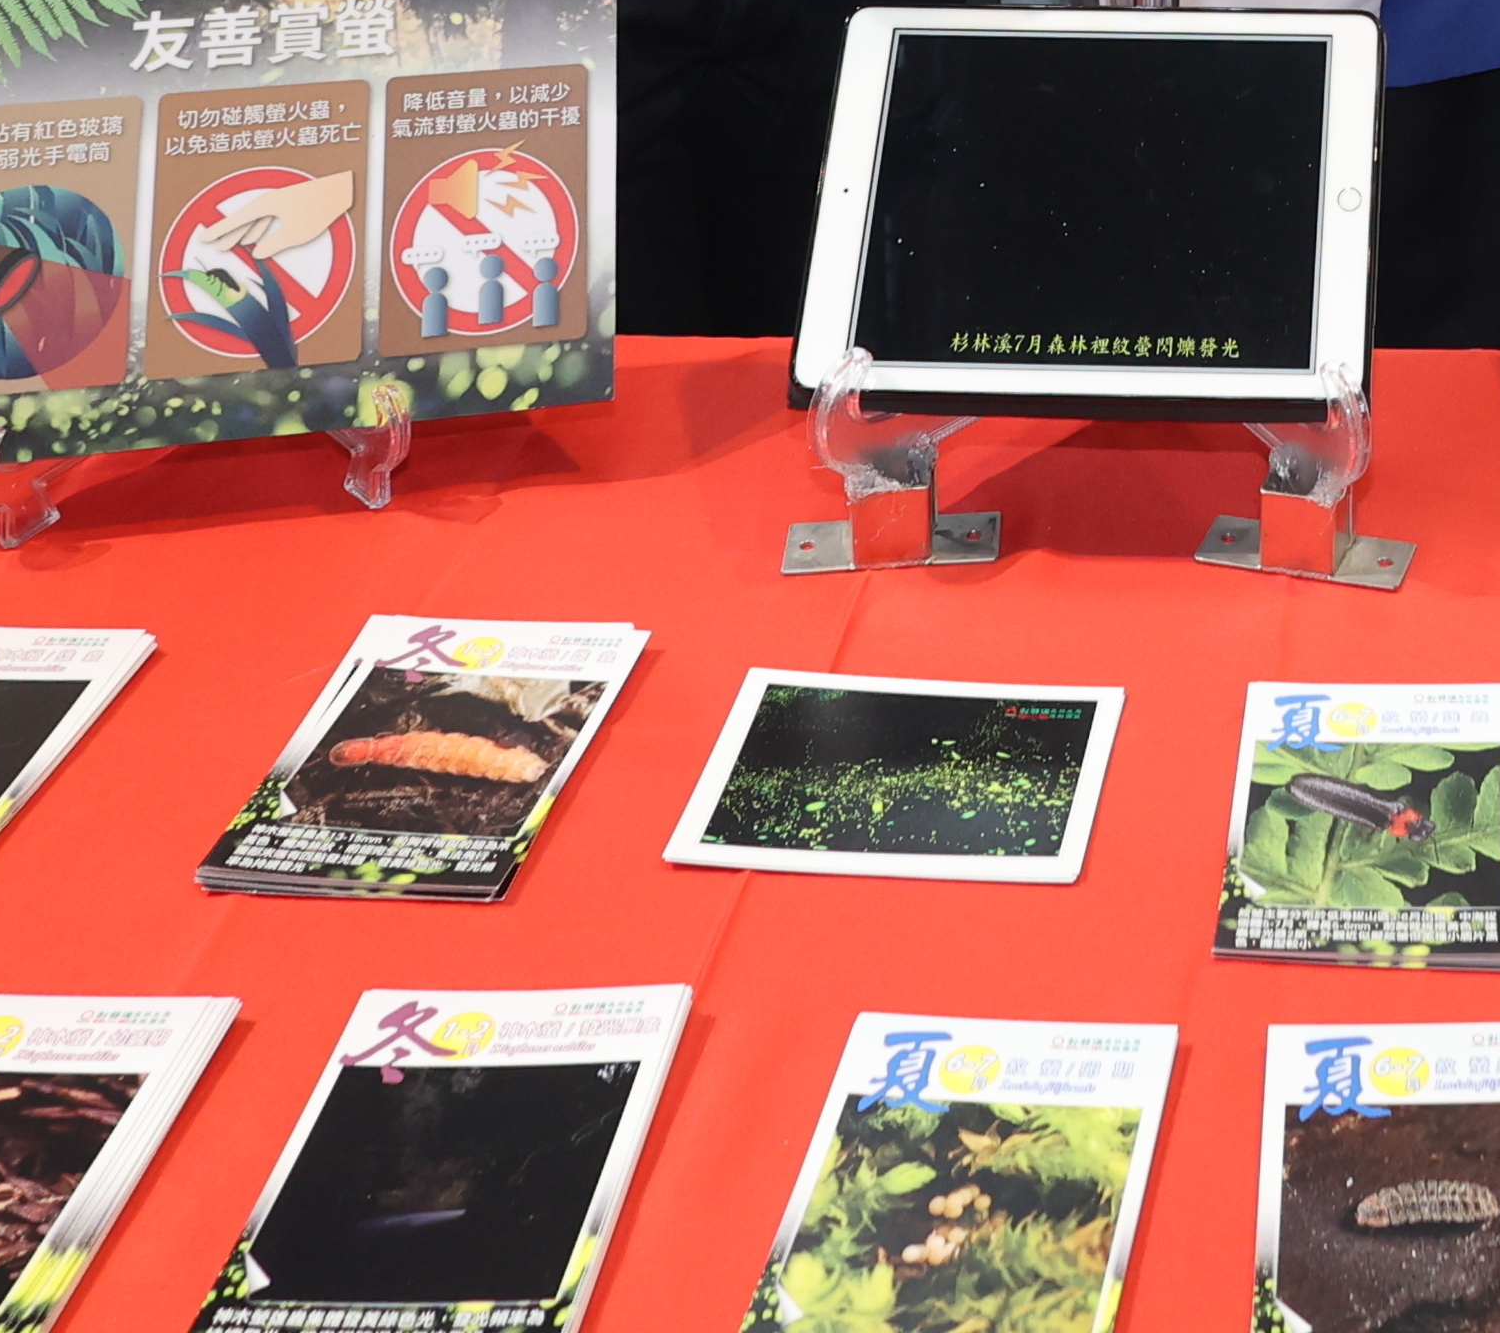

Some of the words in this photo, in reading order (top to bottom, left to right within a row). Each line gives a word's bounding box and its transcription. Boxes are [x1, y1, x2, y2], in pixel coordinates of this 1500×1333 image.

[163, 120, 363, 157] 以免造成螢火蟲死亡
[391, 104, 581, 138] 氣流對螢火蟲的干擾
[376, 624, 467, 684] 冬
[1266, 693, 1344, 752] 夏
[338, 1000, 457, 1085] 冬
[857, 1030, 954, 1114] 夏
[1298, 1036, 1392, 1122] 夏
